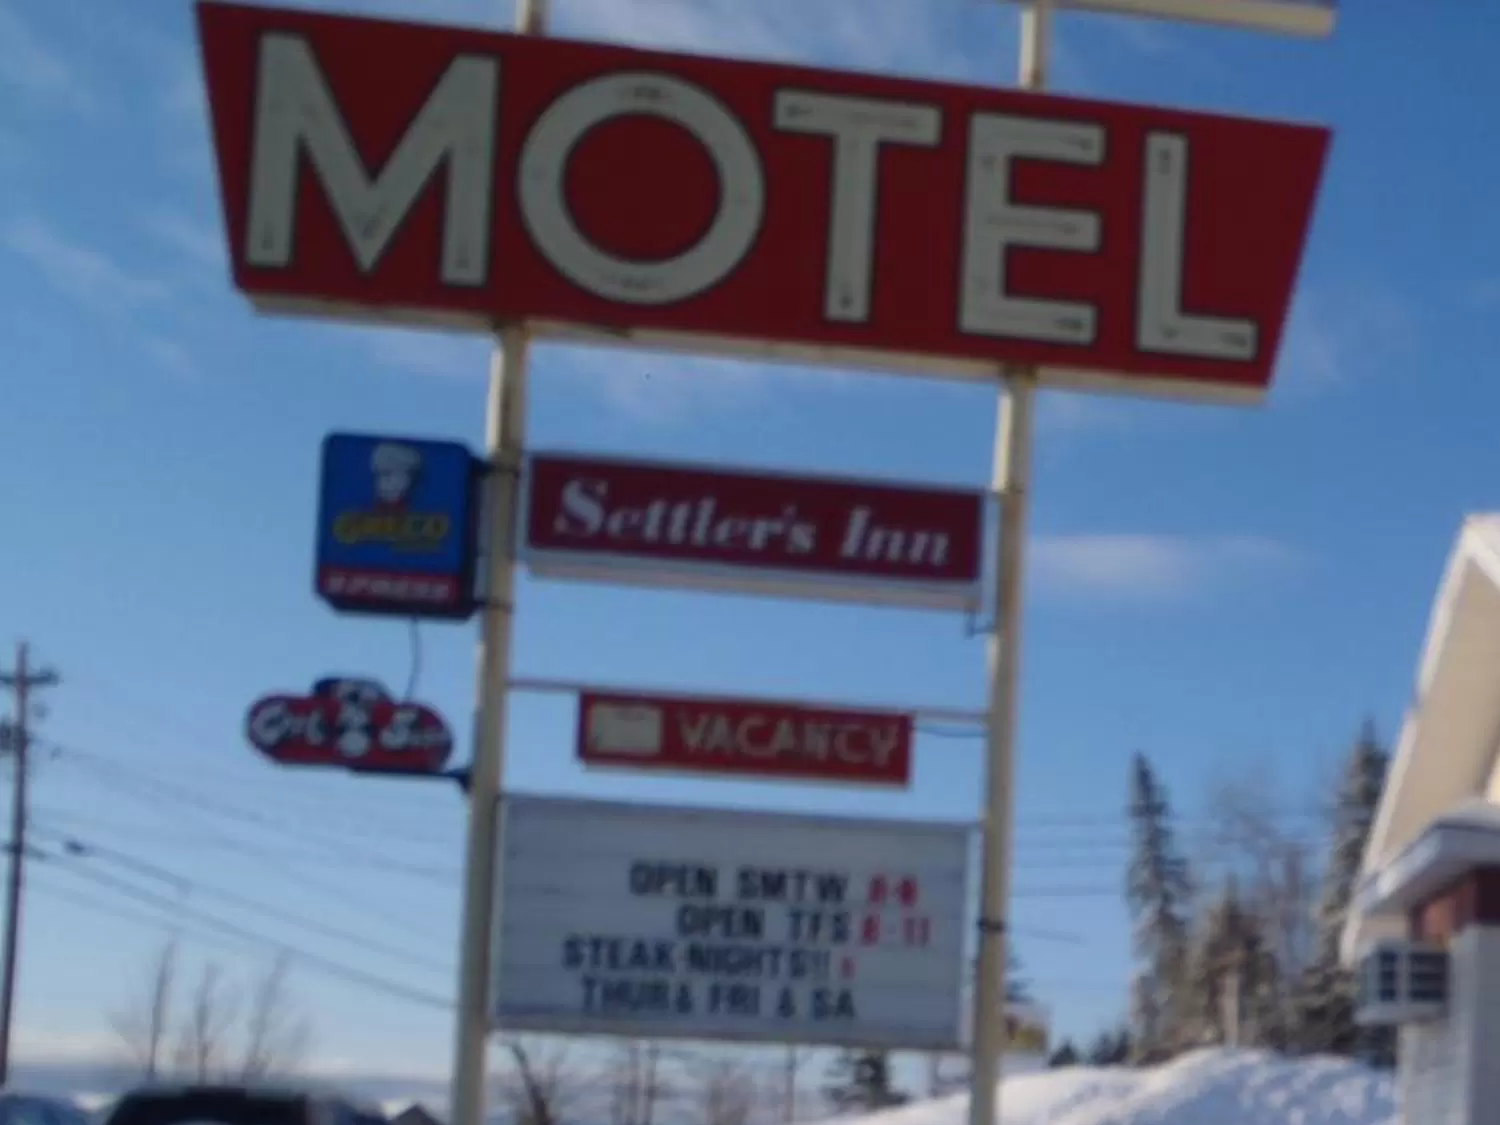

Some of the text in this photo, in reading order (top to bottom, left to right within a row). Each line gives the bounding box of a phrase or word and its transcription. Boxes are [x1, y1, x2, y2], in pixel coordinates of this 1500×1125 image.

[243, 31, 1258, 361] MOTEL
[553, 478, 950, 566] Settler's Inn
[676, 707, 900, 768] VACANCY
[629, 861, 717, 898] OPEN
[676, 905, 764, 940] OPEN
[561, 933, 676, 972] STEAK
[708, 981, 762, 1017] FRI
